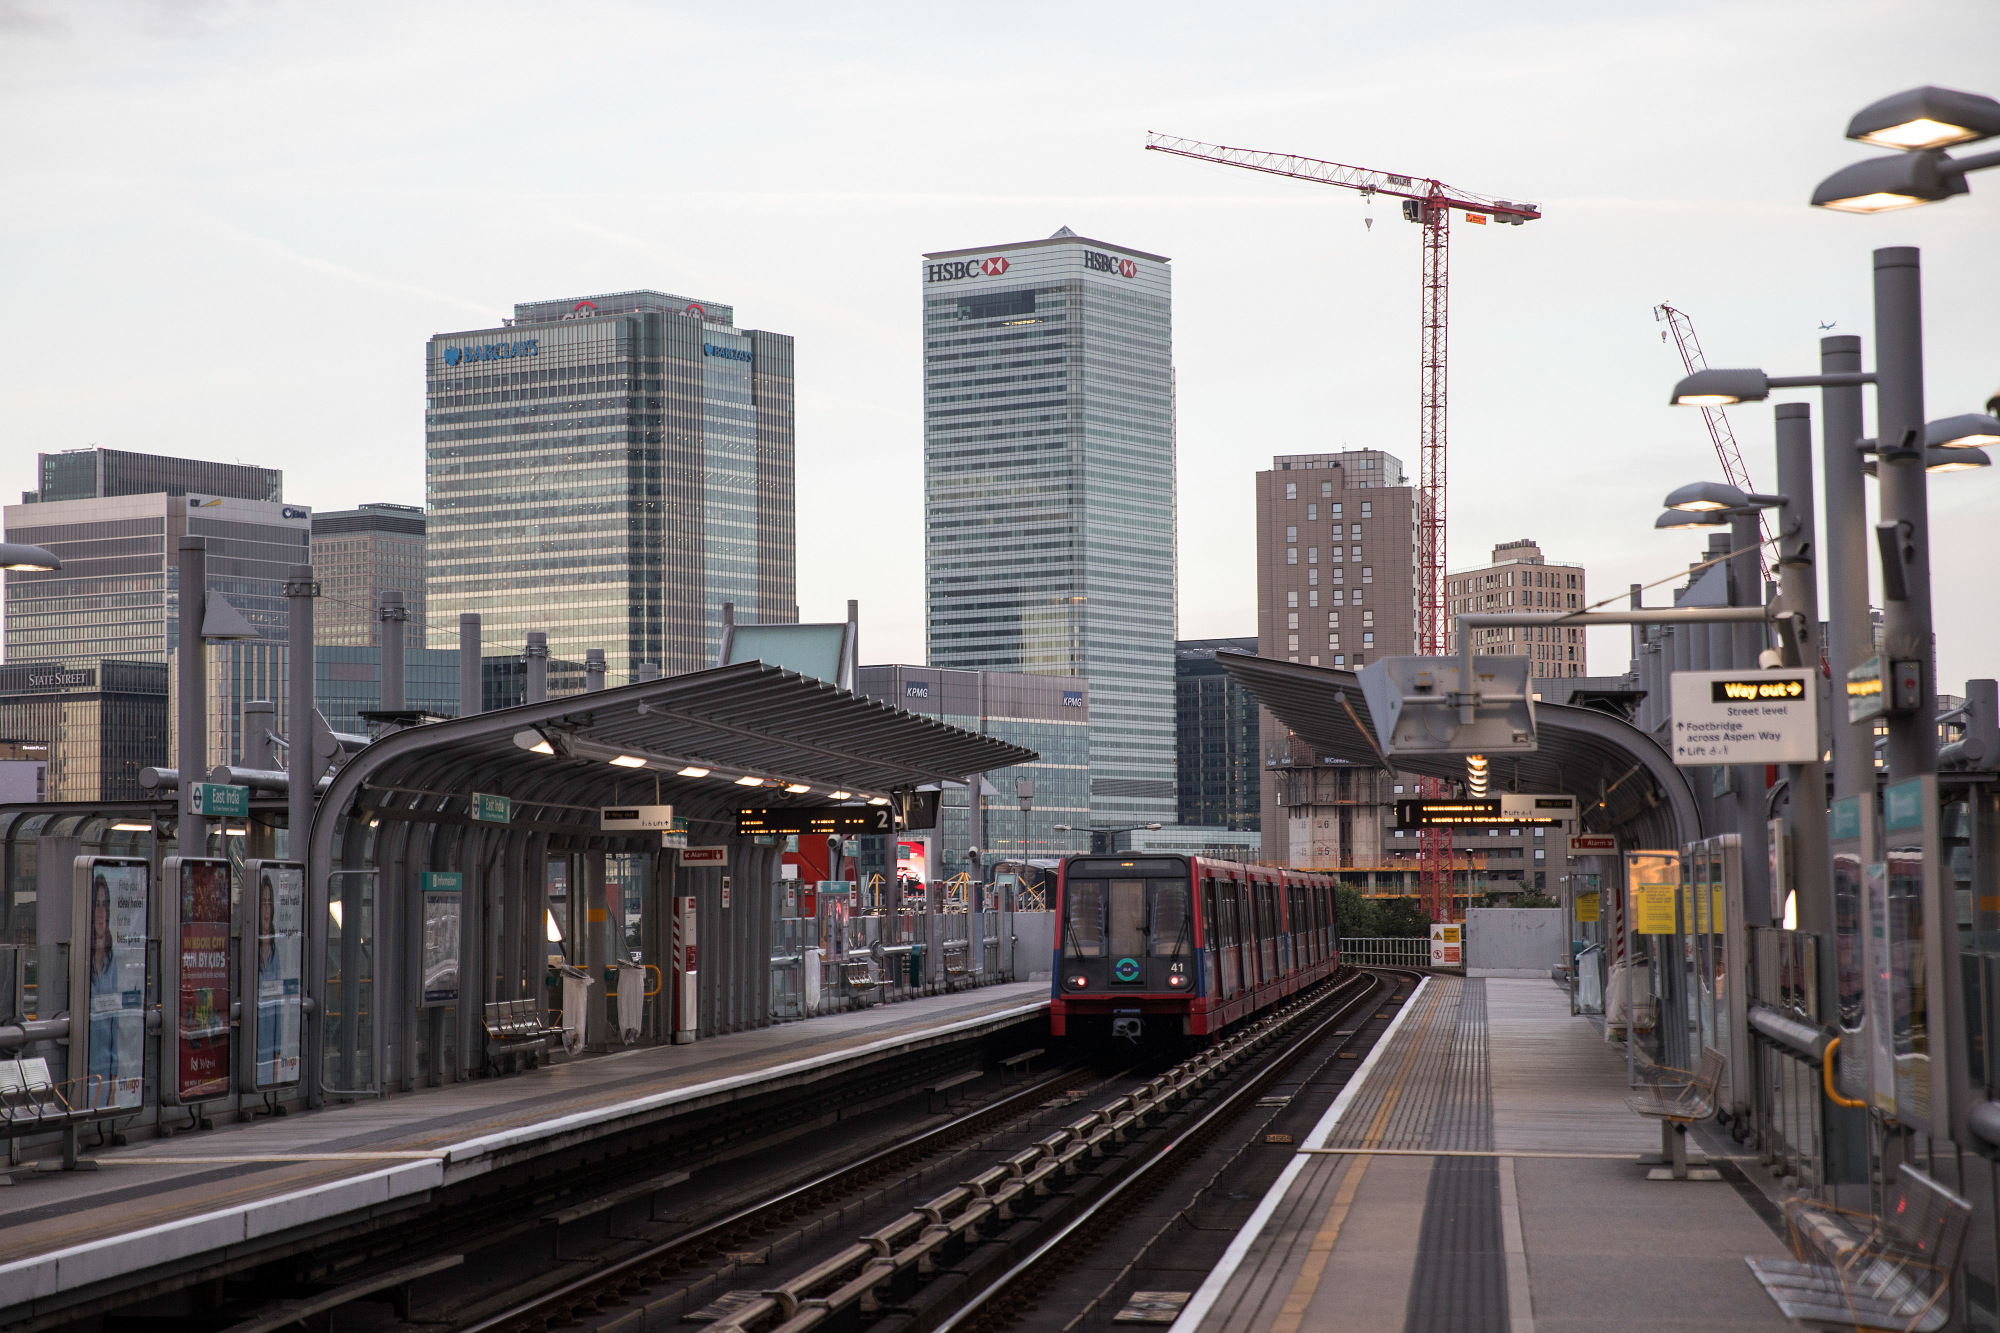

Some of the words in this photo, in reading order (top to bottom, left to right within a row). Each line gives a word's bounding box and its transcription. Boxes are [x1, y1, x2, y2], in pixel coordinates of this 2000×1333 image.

[1084, 250, 1119, 274] HSBC
[927, 259, 980, 283] HSBC
[463, 338, 538, 363] BARCLAYS
[714, 346, 753, 362] BARCLAYS
[29, 674, 54, 686] STATE
[55, 673, 86, 685] STREET
[906, 687, 928, 698] KPMG
[1725, 683, 1758, 700] Way
[1759, 682, 1786, 697] out
[1063, 697, 1082, 707] KPMG
[1727, 707, 1759, 716] Street
[1762, 706, 1788, 715] level
[1687, 722, 1743, 732] Footbridge
[1723, 733, 1755, 743] Aspen
[1758, 732, 1781, 742] Way
[1687, 747, 1706, 756] Lift
[212, 788, 225, 804] East
[227, 789, 240, 805] India
[1325, 794, 1330, 802] 7
[485, 797, 494, 812] East
[876, 810, 889, 829] 2
[1405, 805, 1410, 822] 1
[1324, 820, 1329, 828] 6
[1324, 847, 1330, 855] 5
[118, 897, 130, 908] ideal
[130, 897, 144, 908] hotel
[212, 937, 225, 949] CITY
[198, 952, 208, 968] BY
[208, 951, 226, 969] KIDS
[1170, 962, 1184, 973] 41
[281, 1056, 297, 1070] trivago
[119, 1076, 140, 1094] trivago
